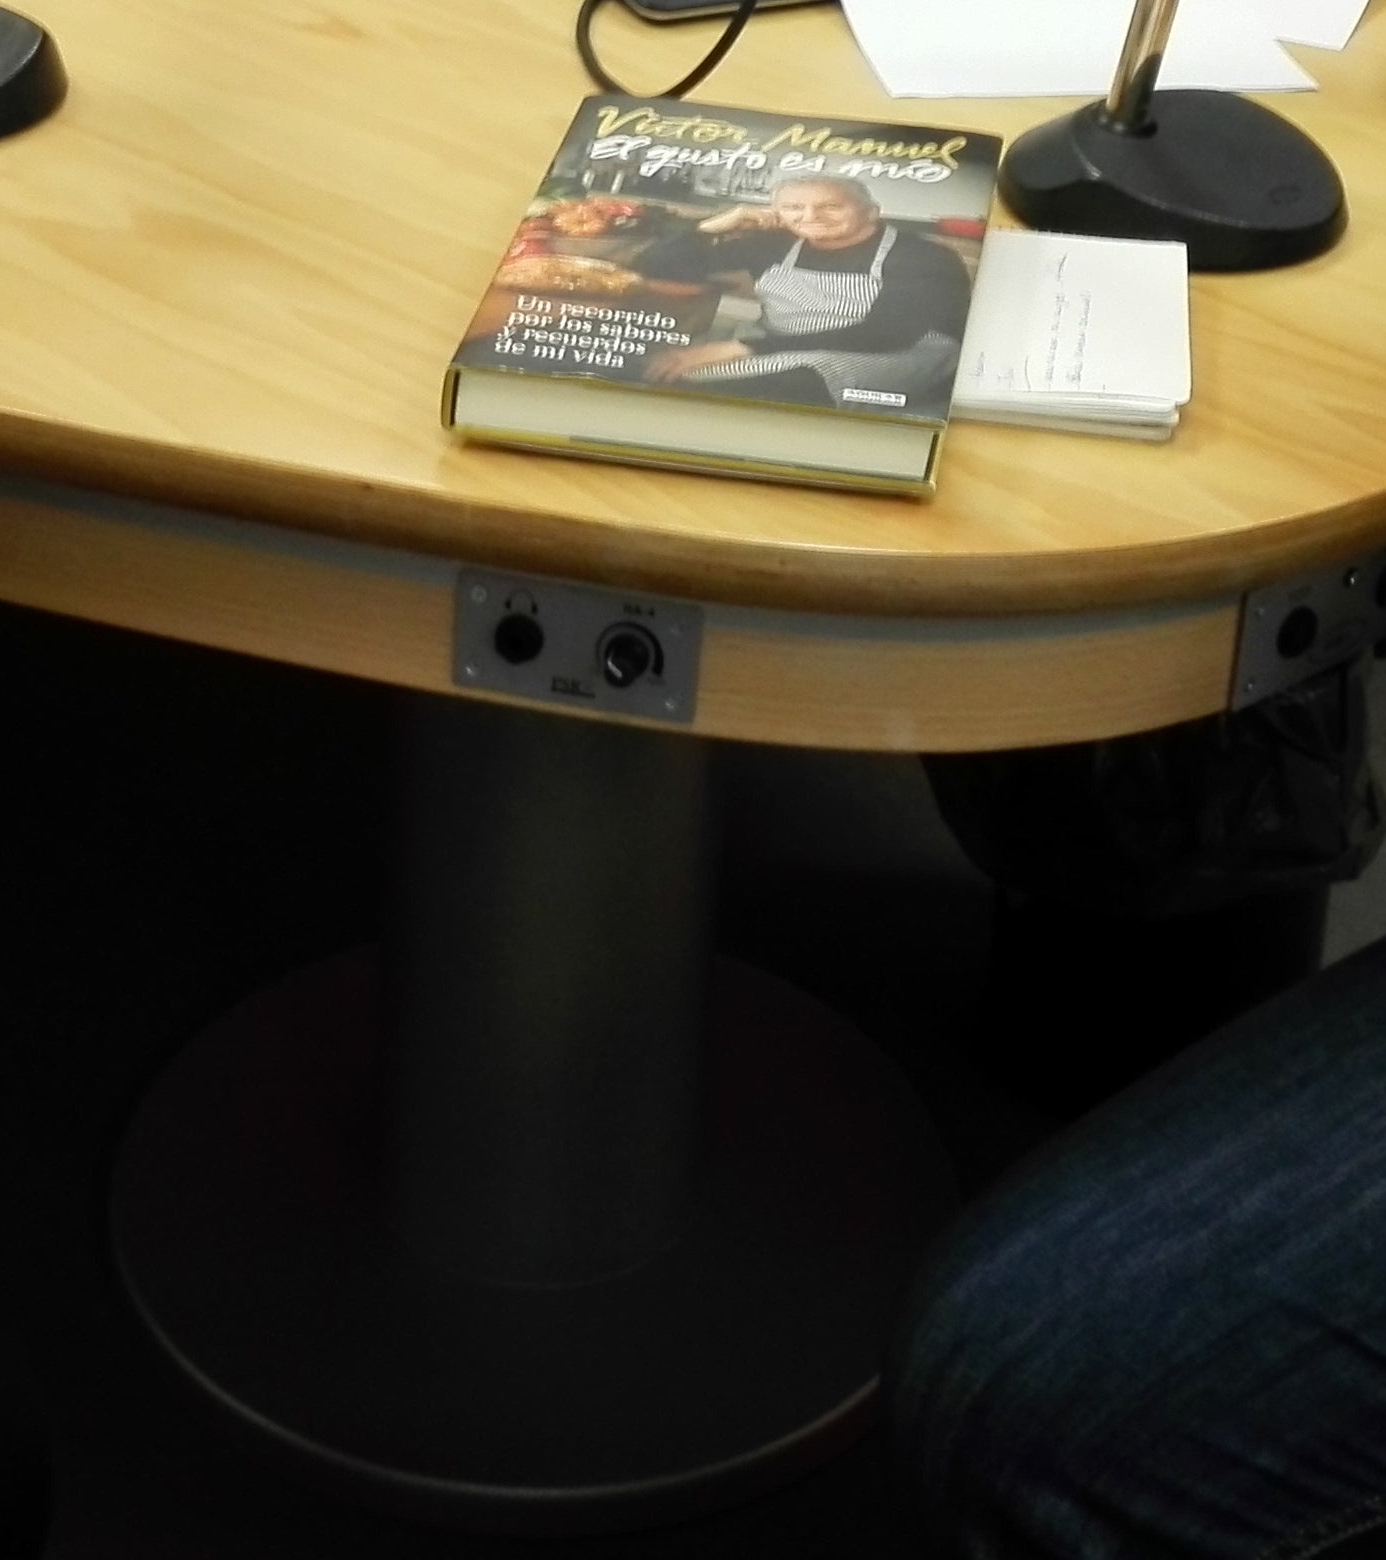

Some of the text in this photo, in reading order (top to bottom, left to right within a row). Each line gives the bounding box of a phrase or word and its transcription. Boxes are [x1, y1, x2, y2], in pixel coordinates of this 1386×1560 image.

[639, 142, 768, 177] gusto
[780, 151, 826, 172] es
[507, 311, 692, 347] por los sabores
[517, 294, 677, 329] Un recorrido
[494, 338, 625, 369] de mi vida
[497, 325, 647, 355] y recuerdos
